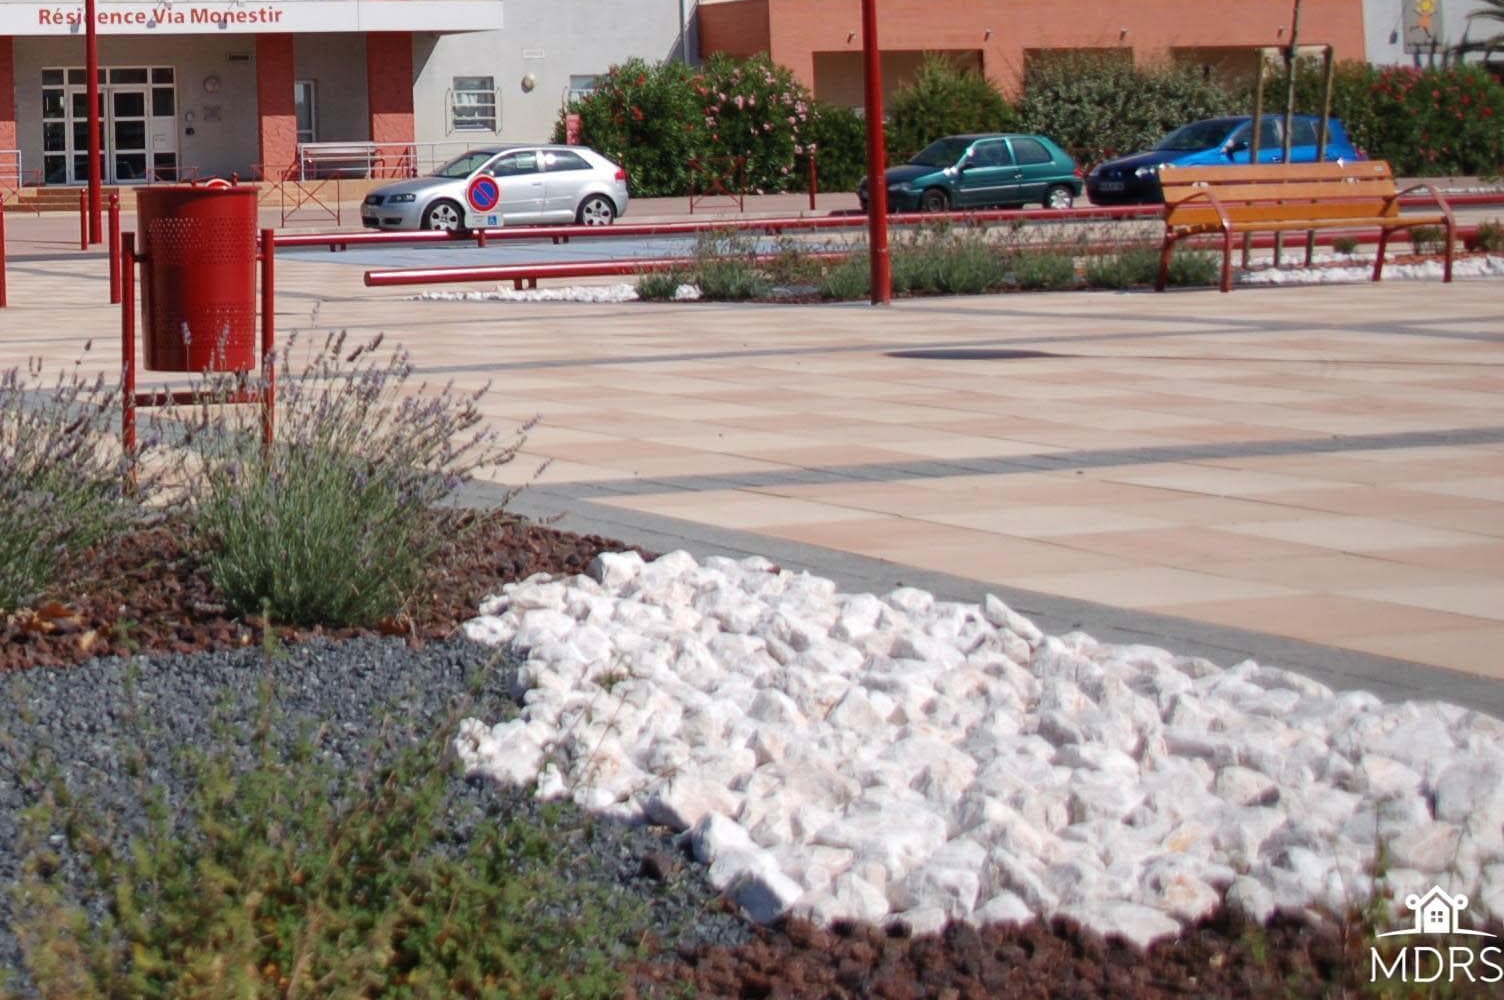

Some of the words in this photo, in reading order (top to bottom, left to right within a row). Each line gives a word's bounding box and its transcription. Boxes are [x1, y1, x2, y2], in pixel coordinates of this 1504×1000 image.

[39, 8, 146, 25] Résience
[153, 7, 185, 24] Via
[190, 6, 283, 24] Monestir
